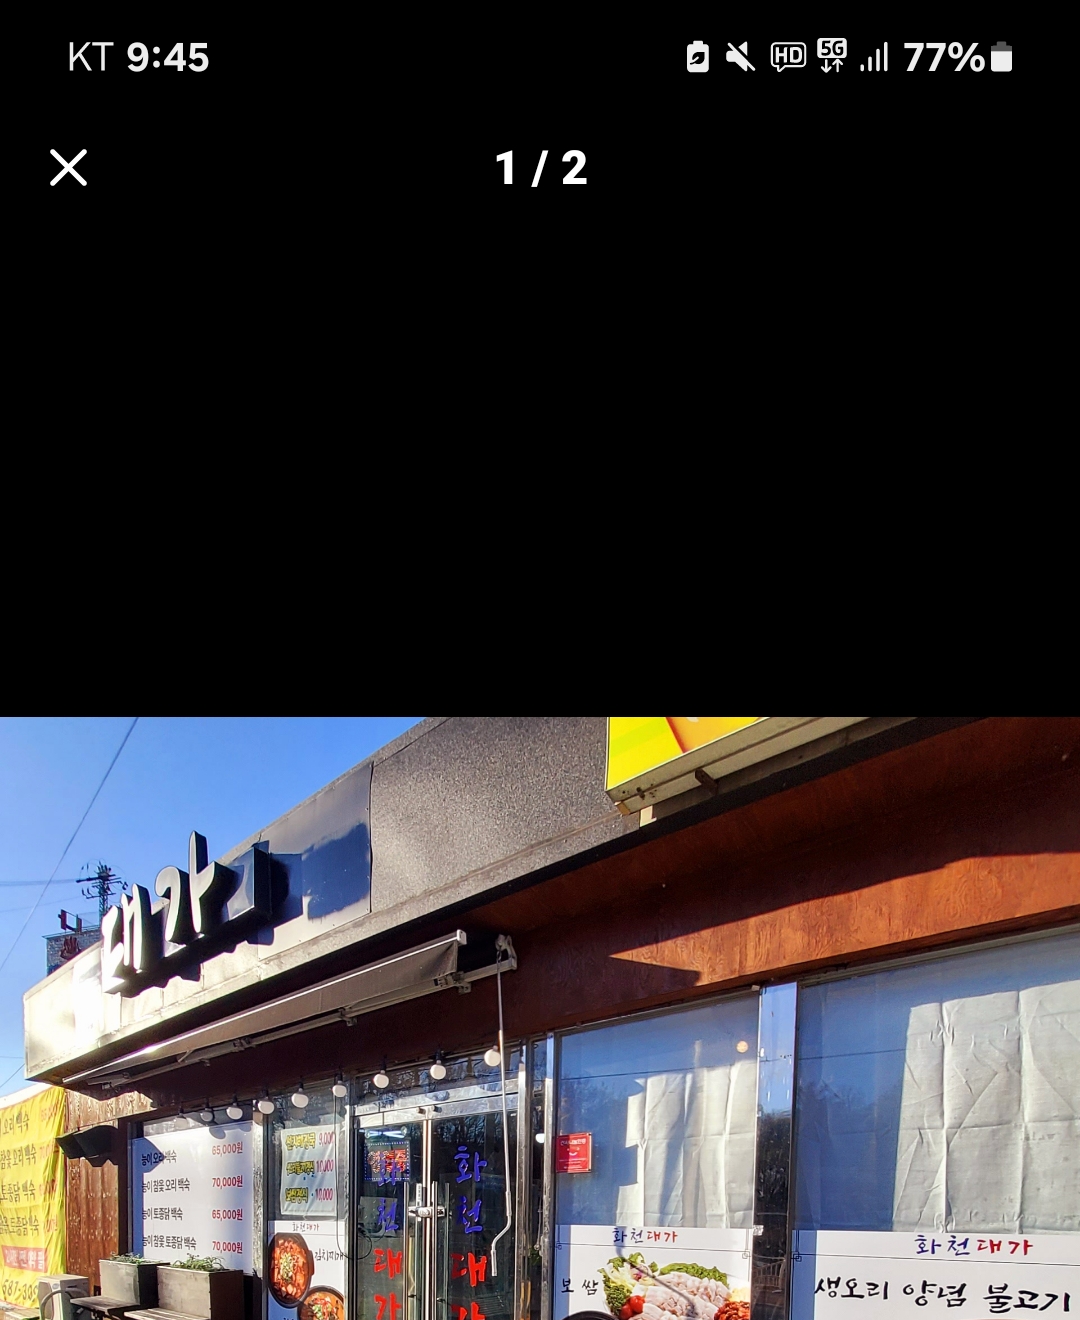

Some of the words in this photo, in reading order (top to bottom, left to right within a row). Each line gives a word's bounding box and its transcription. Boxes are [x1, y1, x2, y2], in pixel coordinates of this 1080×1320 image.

[101, 830, 218, 974] 대가
[212, 1141, 243, 1157] 65,000원
[165, 1178, 177, 1192] 오리
[212, 1175, 243, 1190] 70,000원
[153, 1207, 170, 1221] 토종닭
[212, 1208, 243, 1222] 65,000원
[292, 1221, 320, 1232] 화천대가
[612, 1228, 678, 1244] 화천대가
[165, 1236, 183, 1250] 토종닭
[212, 1241, 243, 1254] 70,000원
[914, 1234, 1033, 1256] 화천대가
[314, 1248, 344, 1262] 김치찌개
[814, 1276, 889, 1300] 생오리
[903, 1280, 967, 1307] 양념
[983, 1283, 1071, 1314] 불고기
